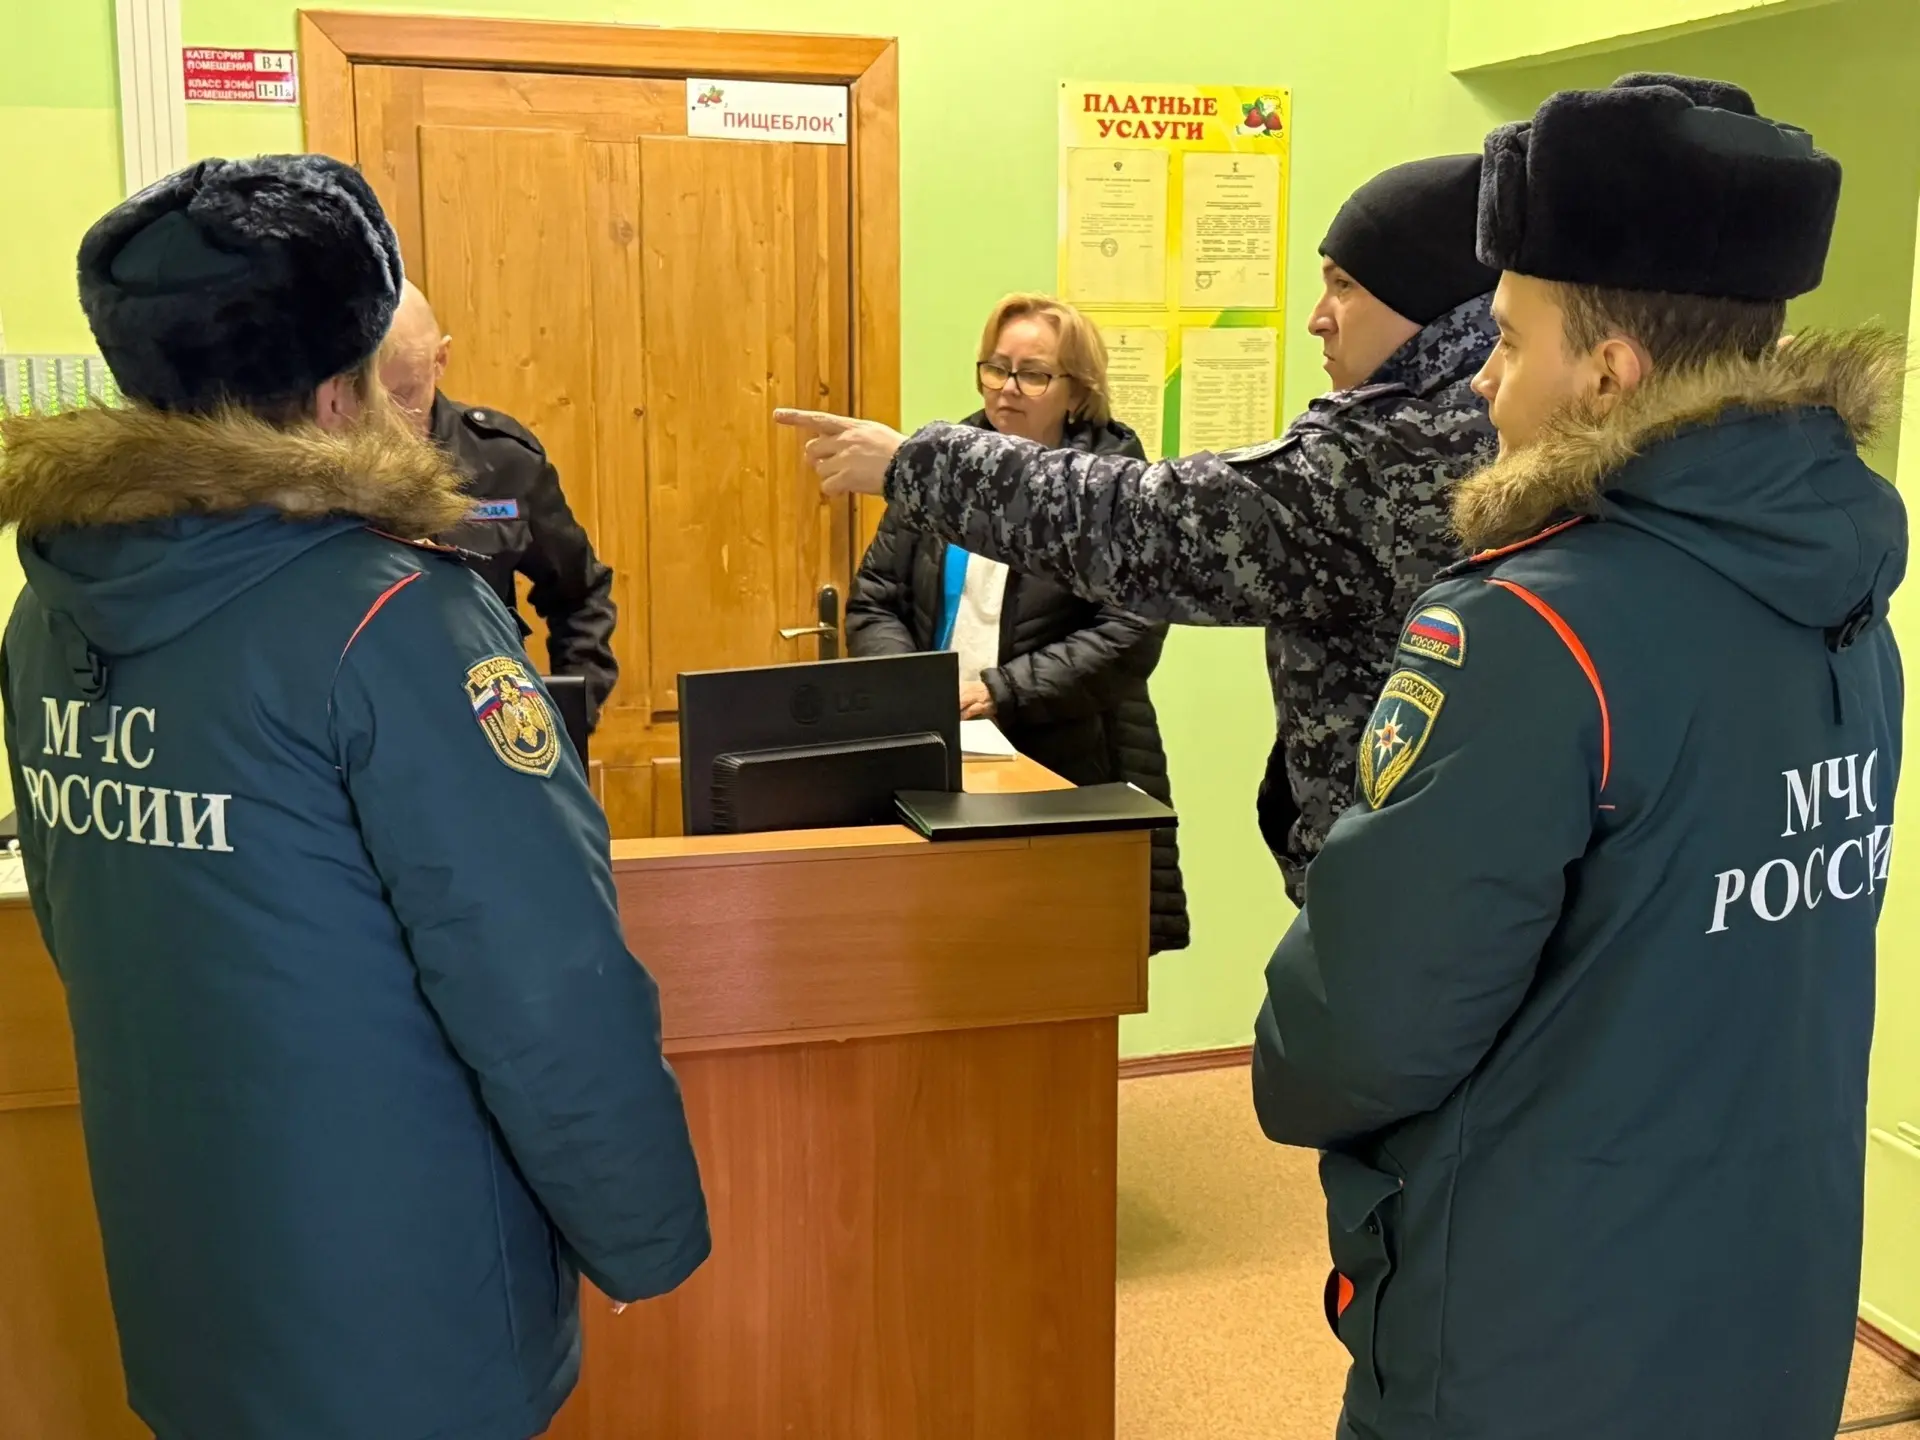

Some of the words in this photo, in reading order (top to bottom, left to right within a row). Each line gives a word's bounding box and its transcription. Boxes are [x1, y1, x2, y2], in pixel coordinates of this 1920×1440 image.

[186, 50, 245, 60] КАТЕГОРИЯ
[187, 60, 253, 71] ПОМЕЩЕНИЯ
[262, 56, 271, 69] В
[275, 56, 282, 69] 4
[188, 79, 222, 88] КЛАСС
[223, 80, 254, 89] ЗОНЫ
[188, 89, 255, 99] ПОМЕЩЕНИЯ
[1083, 94, 1218, 116] ПЛАТНЫЕ
[723, 112, 835, 132] ПИЩЕБЛОК
[1097, 119, 1204, 140] УСЛУГИ
[1411, 634, 1450, 655] РОССИЯ
[1401, 678, 1438, 708] РОССИИ
[42, 696, 156, 769] МЧС
[1781, 748, 1878, 837] МЧС
[22, 764, 234, 852] РОССИИ
